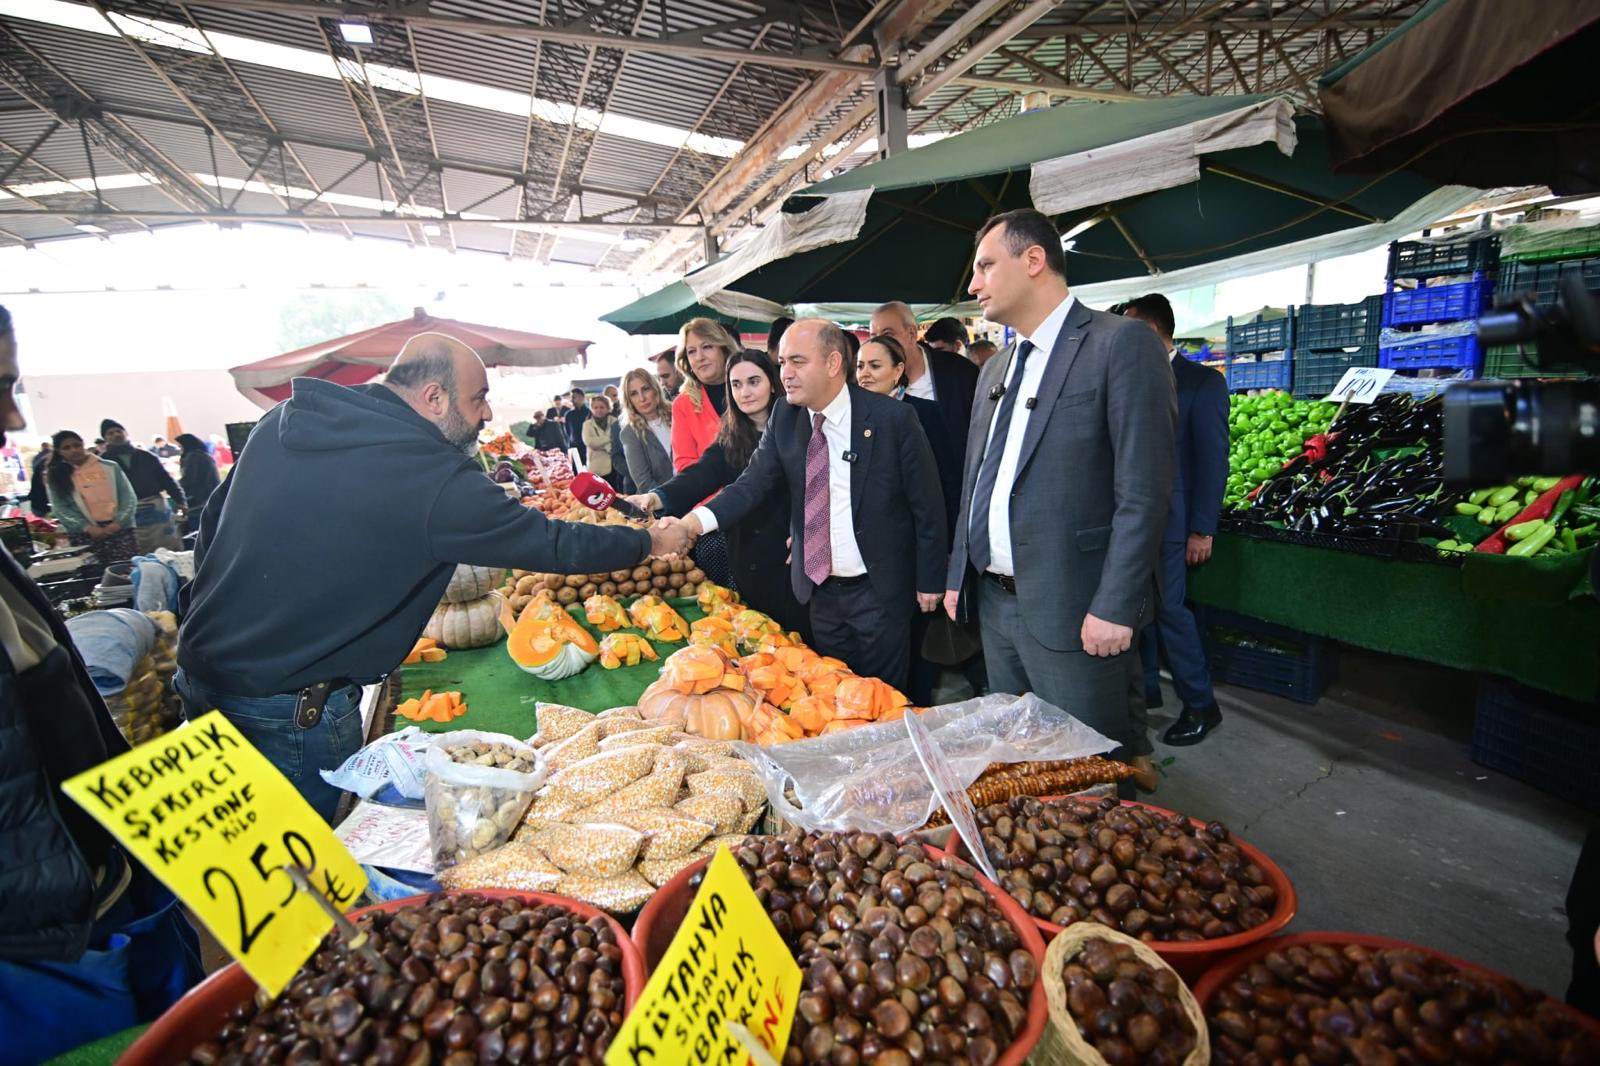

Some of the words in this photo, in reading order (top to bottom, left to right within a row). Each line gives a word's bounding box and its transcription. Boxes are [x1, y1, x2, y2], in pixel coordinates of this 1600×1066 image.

[87, 722, 239, 810] KEBAPLIK
[124, 755, 236, 839] ŞEKERCİ
[154, 783, 255, 864] KESTANE
[203, 831, 316, 954] 250
[628, 893, 728, 1066] KÜTAHYA
